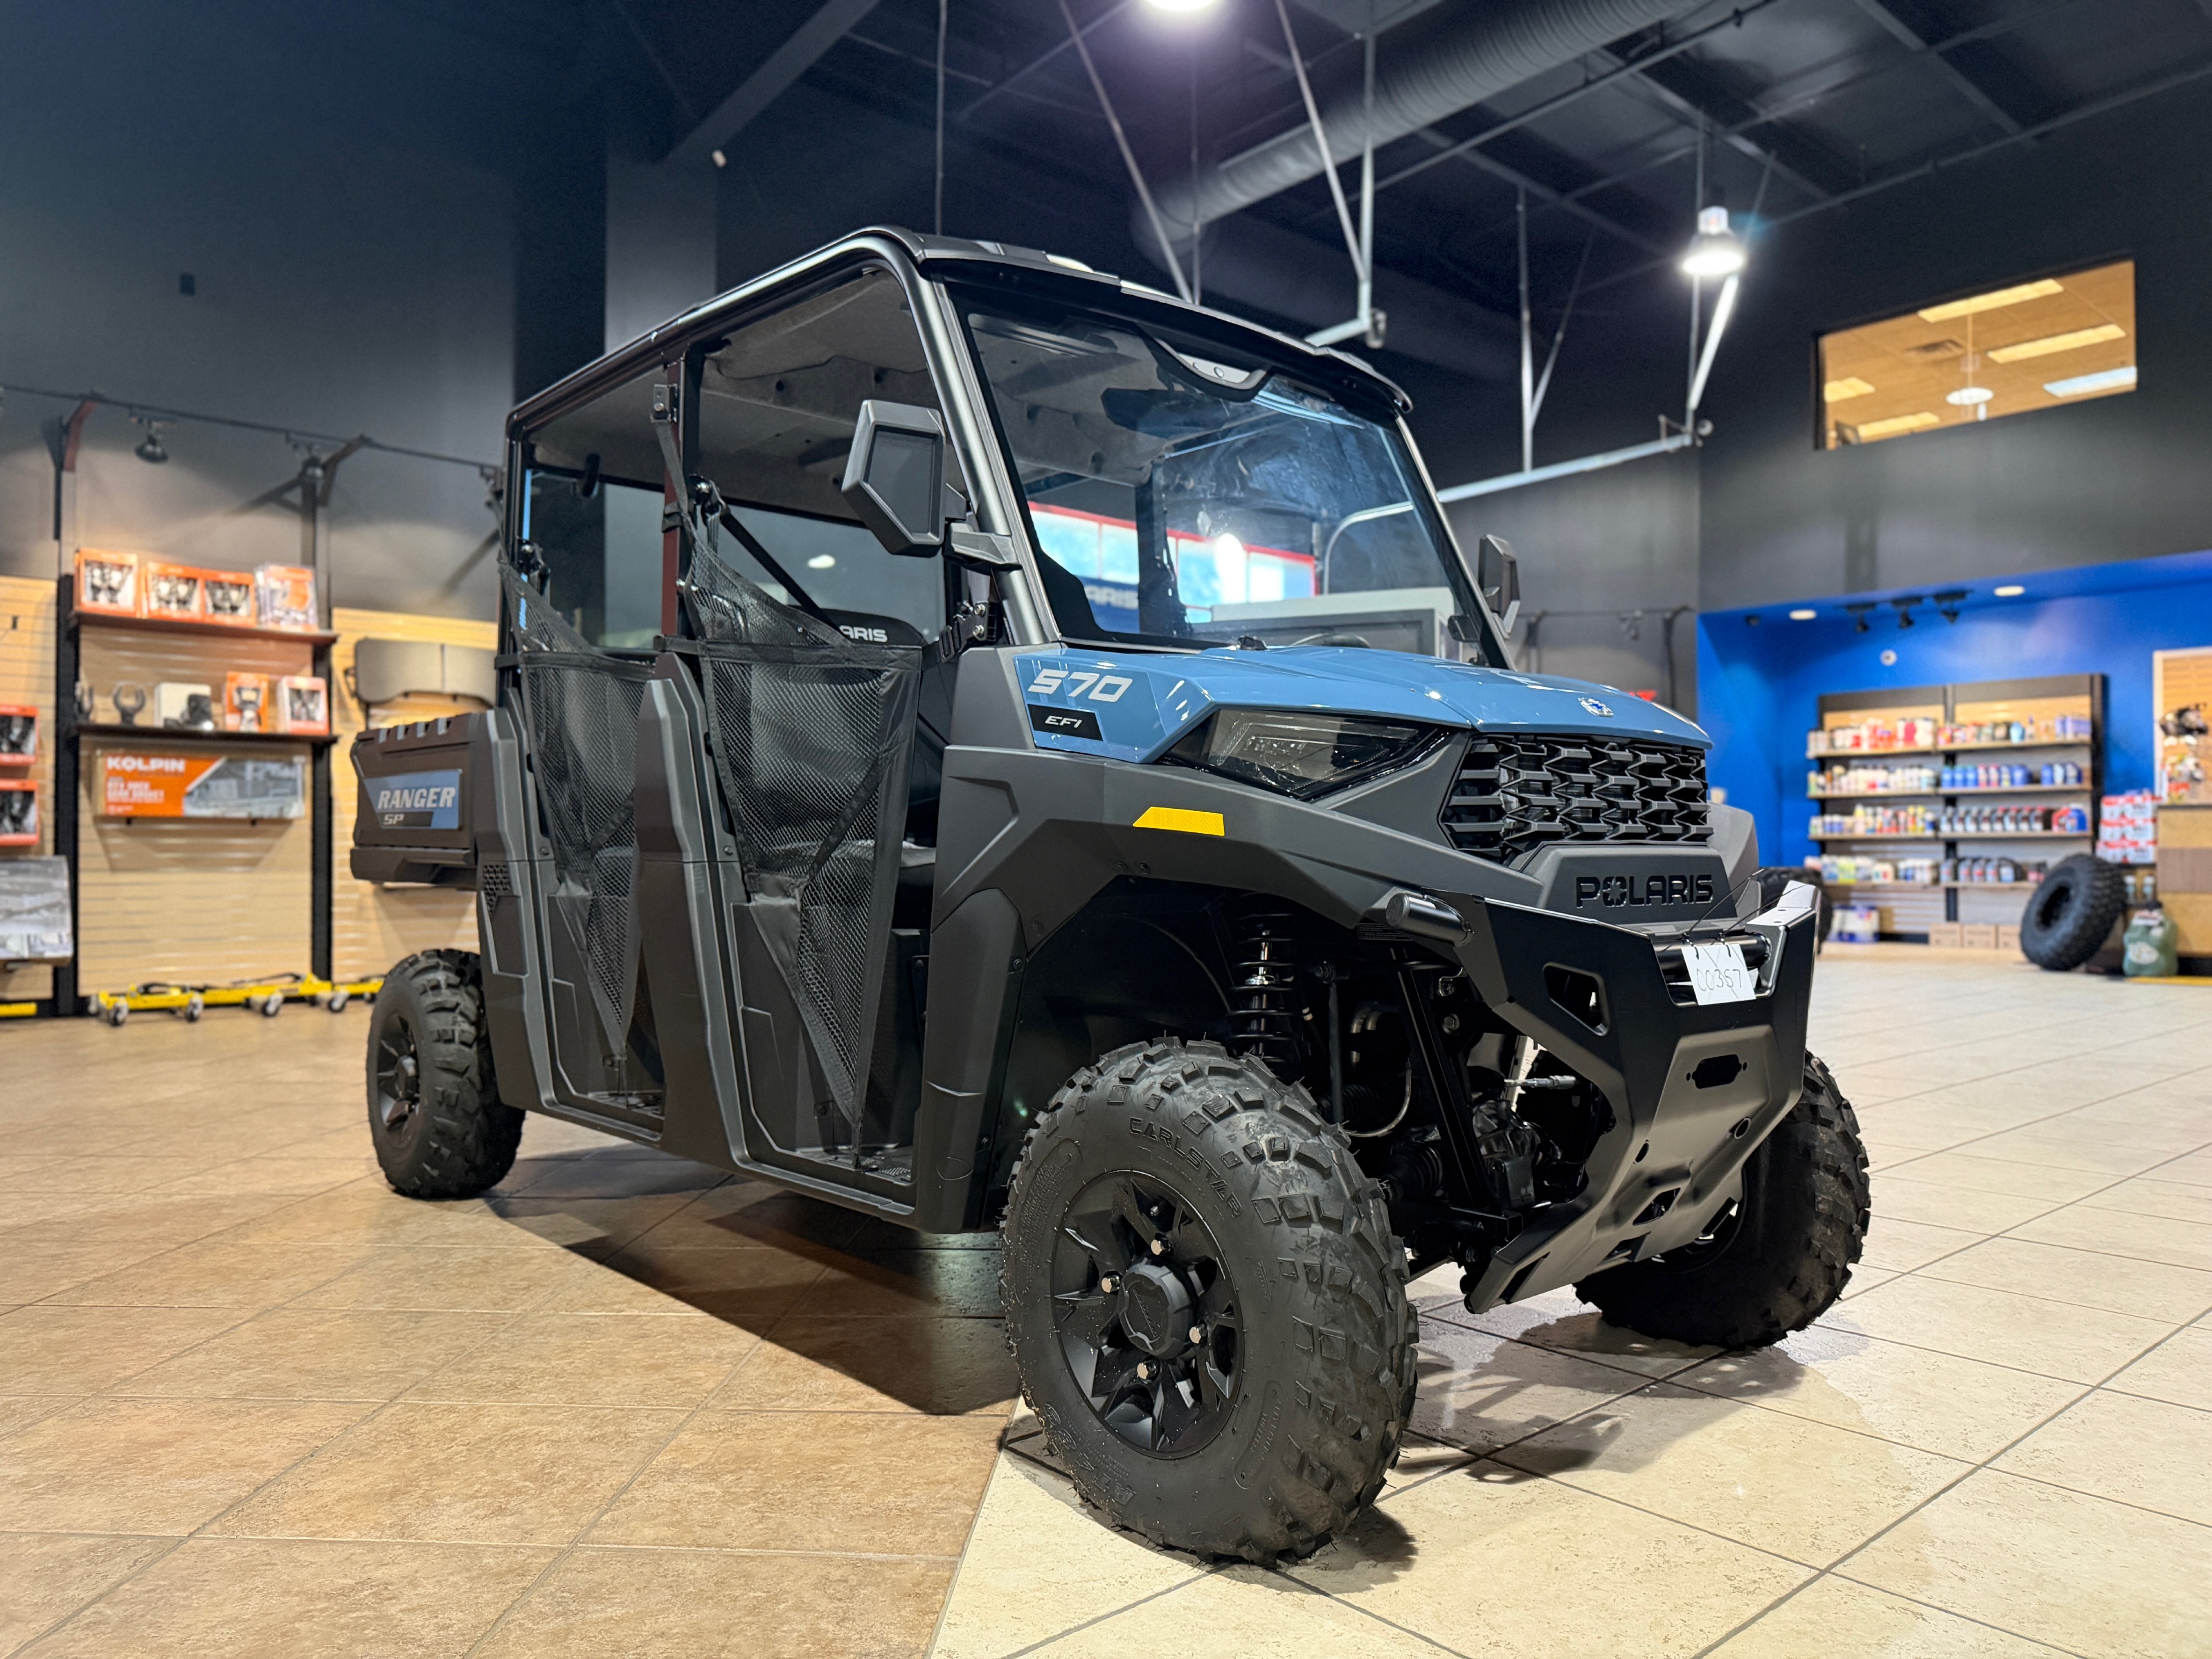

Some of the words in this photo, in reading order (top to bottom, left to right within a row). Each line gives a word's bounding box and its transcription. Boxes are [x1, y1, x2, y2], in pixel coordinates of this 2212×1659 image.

[1028, 669, 1134, 703] 570
[1044, 715, 1083, 728] EFI
[107, 756, 185, 772] KOLPIN
[377, 787, 456, 809] RANGER
[383, 814, 405, 825] SP
[1575, 874, 1714, 908] POLARIS
[1129, 1117, 1243, 1219] CARLSTAR
